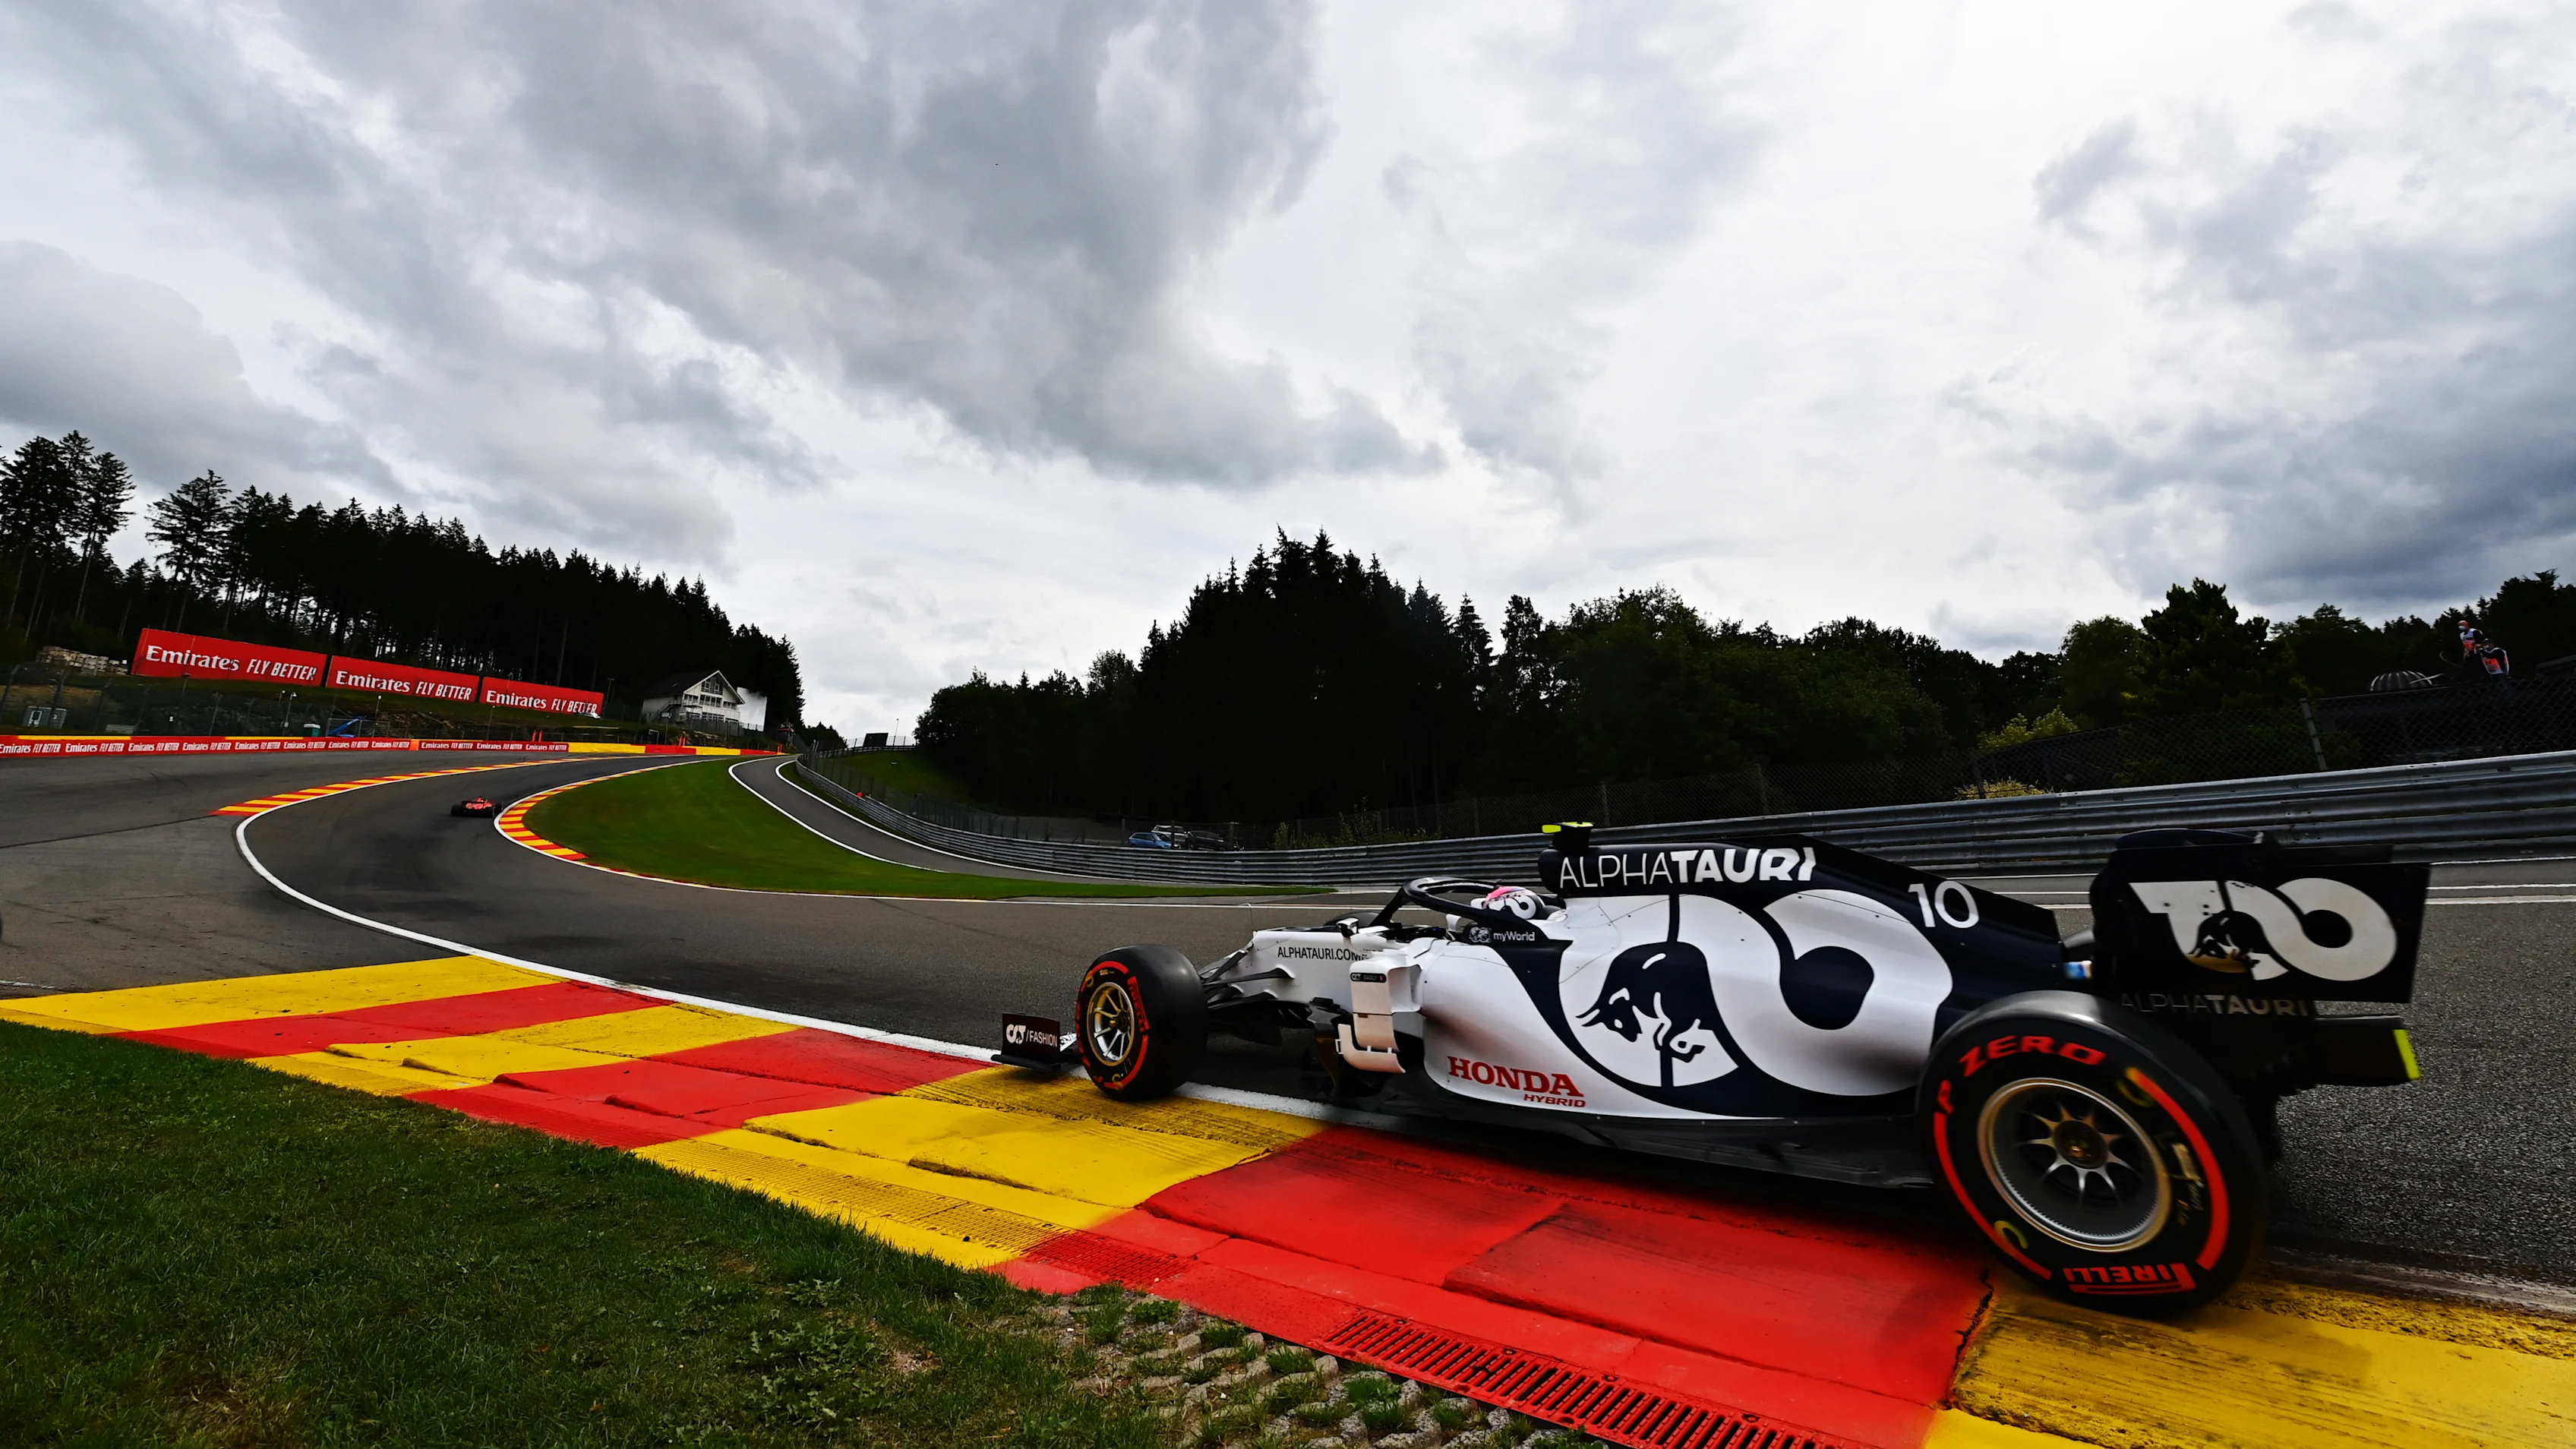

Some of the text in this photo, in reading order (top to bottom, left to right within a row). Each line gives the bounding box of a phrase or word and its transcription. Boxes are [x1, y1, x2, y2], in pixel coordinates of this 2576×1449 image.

[146, 645, 317, 681] Emirates FLY BETTER
[336, 670, 472, 701] Emirates FLY BETTER
[486, 690, 598, 714] Emirates FLY BETTER
[0, 743, 31, 754] Emirates
[65, 743, 97, 753] Emirates
[128, 743, 155, 752] Emirates
[182, 743, 208, 751] Emirates
[235, 742, 259, 750] Emirates
[1559, 846, 1817, 889] ALPHATAURI
[1908, 880, 1980, 929] 10
[1493, 931, 1535, 942] myWorld
[2121, 993, 2309, 1017] ALPHATAURI
[1959, 1035, 2107, 1077] ZERO
[1447, 1056, 1584, 1097] HONDA
[1523, 1094, 1586, 1108] HYBRID
[2063, 1262, 2196, 1296] PIRELLI
